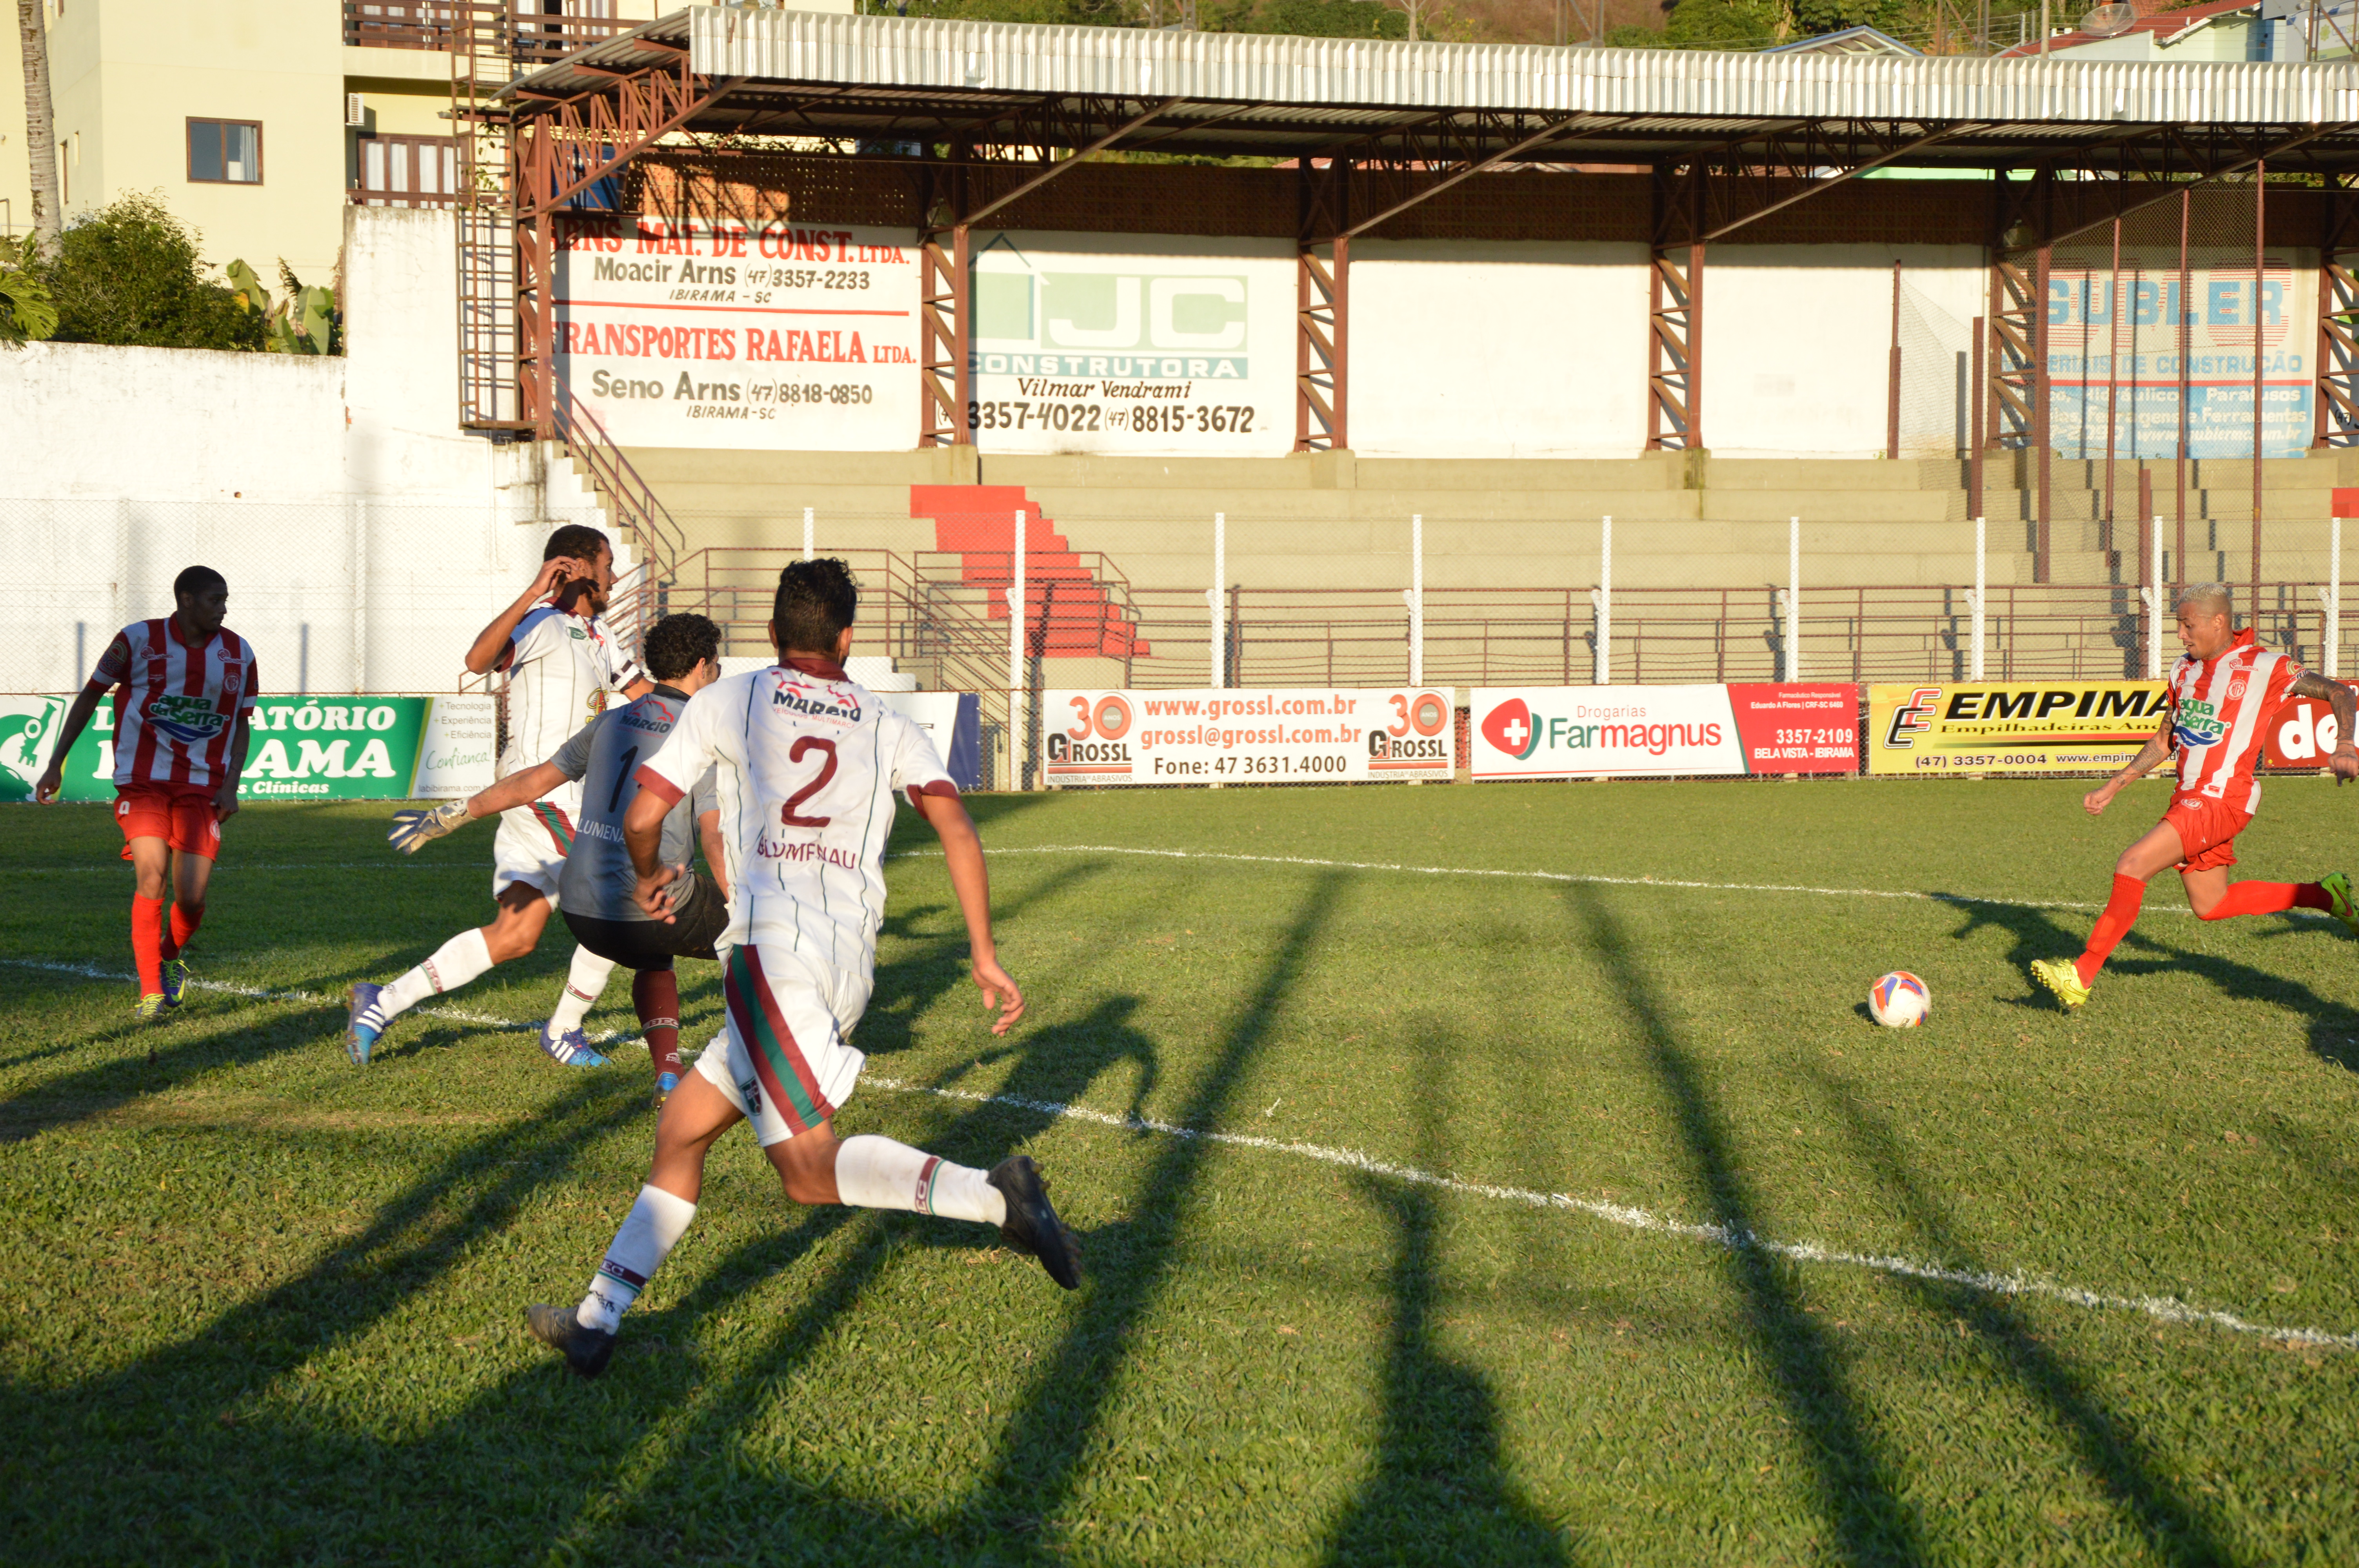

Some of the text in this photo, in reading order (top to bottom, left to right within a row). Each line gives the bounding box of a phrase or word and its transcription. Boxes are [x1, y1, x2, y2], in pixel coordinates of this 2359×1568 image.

[551, 218, 910, 264] ARNS MAT. DE CONST. LTDA.
[594, 256, 672, 283] Moacir
[679, 259, 736, 285] Arns
[670, 289, 735, 302] IBIRAMA
[1049, 276, 1245, 348] JC
[745, 328, 867, 363] RAFAELA
[873, 345, 917, 364] LTDA.
[2122, 356, 2146, 374] DE
[591, 369, 663, 399] Seno
[674, 371, 741, 402] Arns
[1018, 378, 1192, 399] Vilmar Vendrami
[2206, 387, 2301, 401] Parafusos
[2087, 405, 2179, 428] Feragens
[445, 702, 491, 711] Tecnologia
[1067, 696, 1132, 740] 30
[1144, 694, 1356, 720] www.grossl.com.br
[1387, 693, 1447, 737] 30
[1578, 705, 1646, 720] Drogarias
[441, 716, 491, 726] Experiência
[1940, 722, 2112, 735] Empilhadeiras
[451, 730, 492, 739] Eficiência
[1141, 724, 1361, 749] grossl@grossl.com.br
[1369, 730, 1447, 759] GROSSL
[1550, 718, 1722, 755] Farmagnus
[1776, 728, 1853, 744] 3357-2109
[1048, 733, 1132, 763] GROSSL
[1754, 748, 1781, 759] BELA
[1782, 747, 1808, 759] VISTA
[1815, 747, 1854, 758] IBIRAMA
[1953, 753, 2048, 766] 3357-0004
[1155, 756, 1347, 775] Fone: 47 3631.4000
[252, 780, 329, 794] Clínicas
[609, 745, 638, 813] 1
[781, 735, 838, 828] 2
[1047, 775, 1087, 783] INDÚSTRIA
[1091, 774, 1133, 782] ABRASIVOS
[757, 837, 856, 869] BLUMENAU
